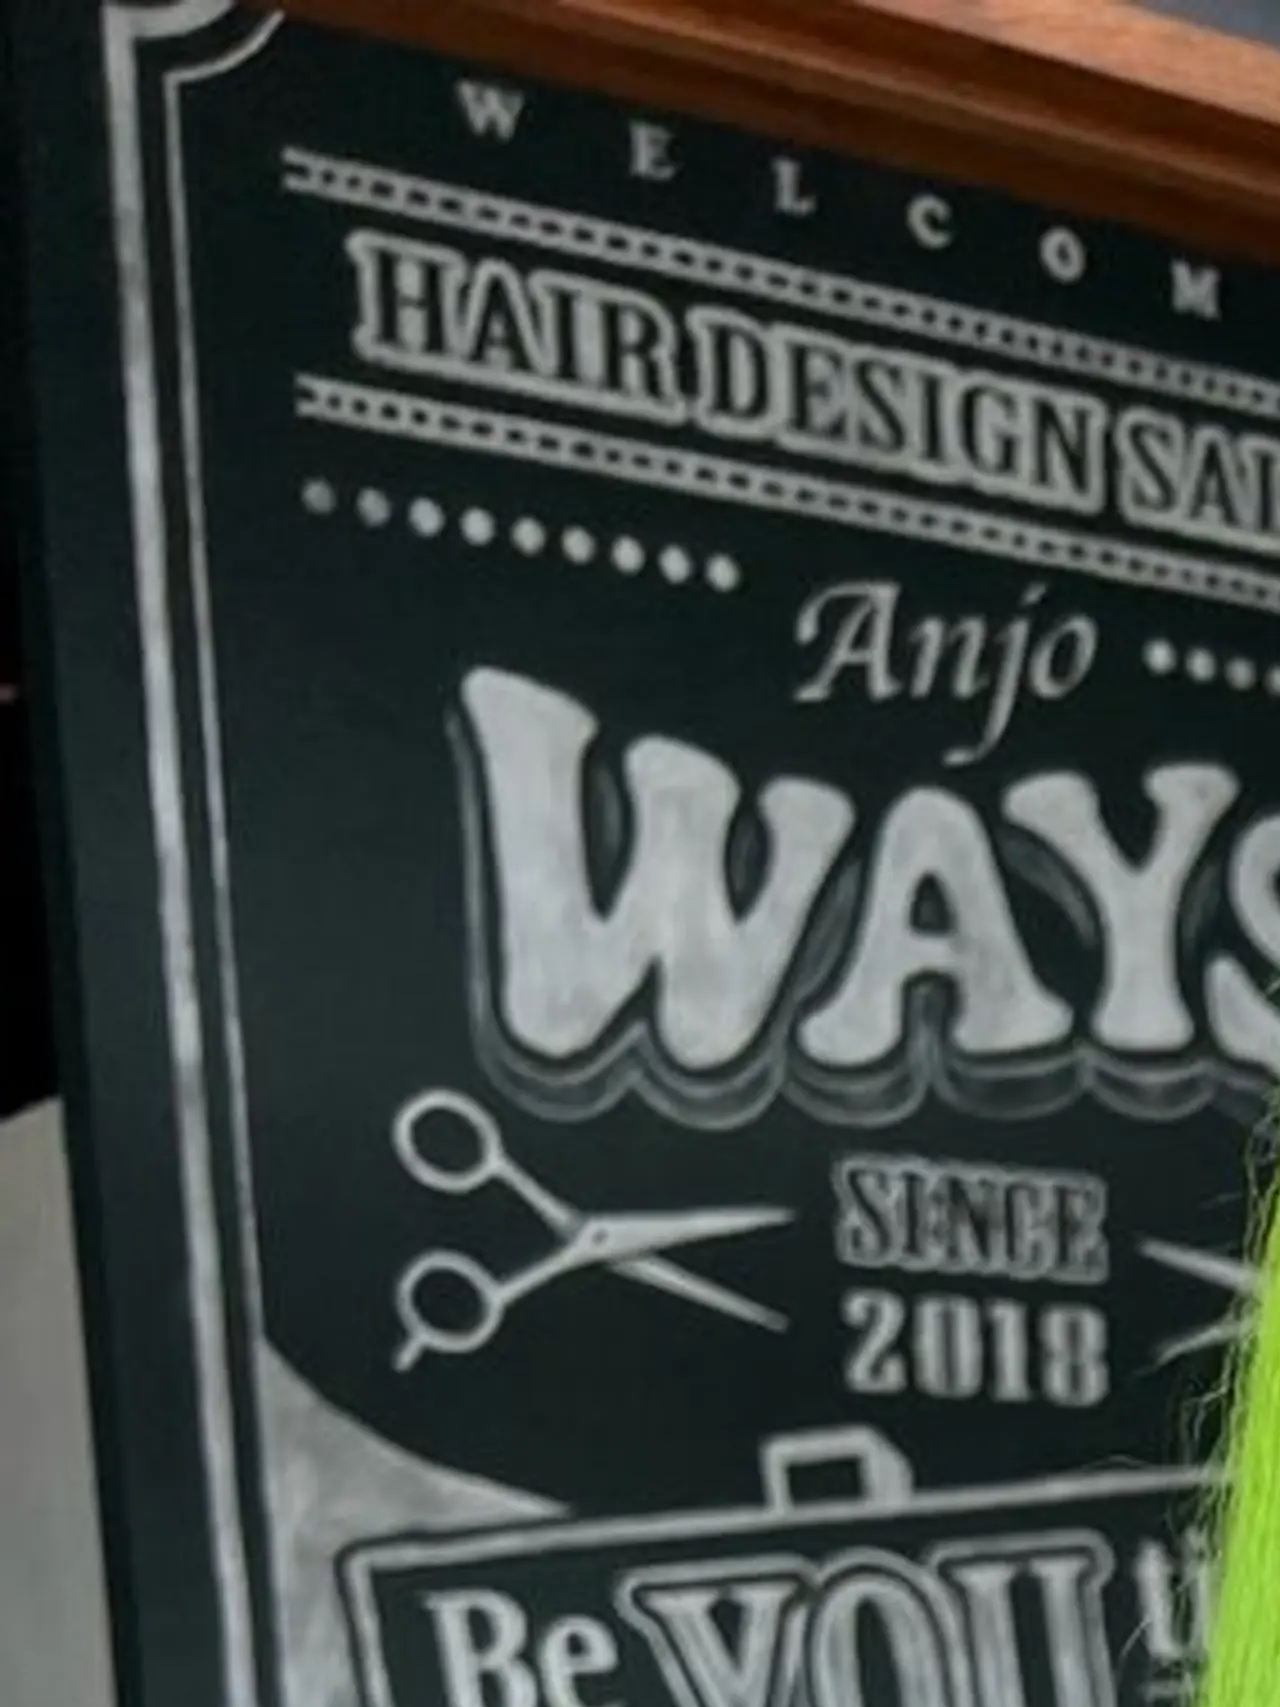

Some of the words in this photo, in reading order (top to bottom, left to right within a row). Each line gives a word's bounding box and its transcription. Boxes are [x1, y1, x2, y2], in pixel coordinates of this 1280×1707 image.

[345, 230, 686, 426] HAIR
[686, 304, 1106, 516] DESIGN
[792, 580, 1100, 765] Anjo
[840, 1287, 1110, 1406] 2018
